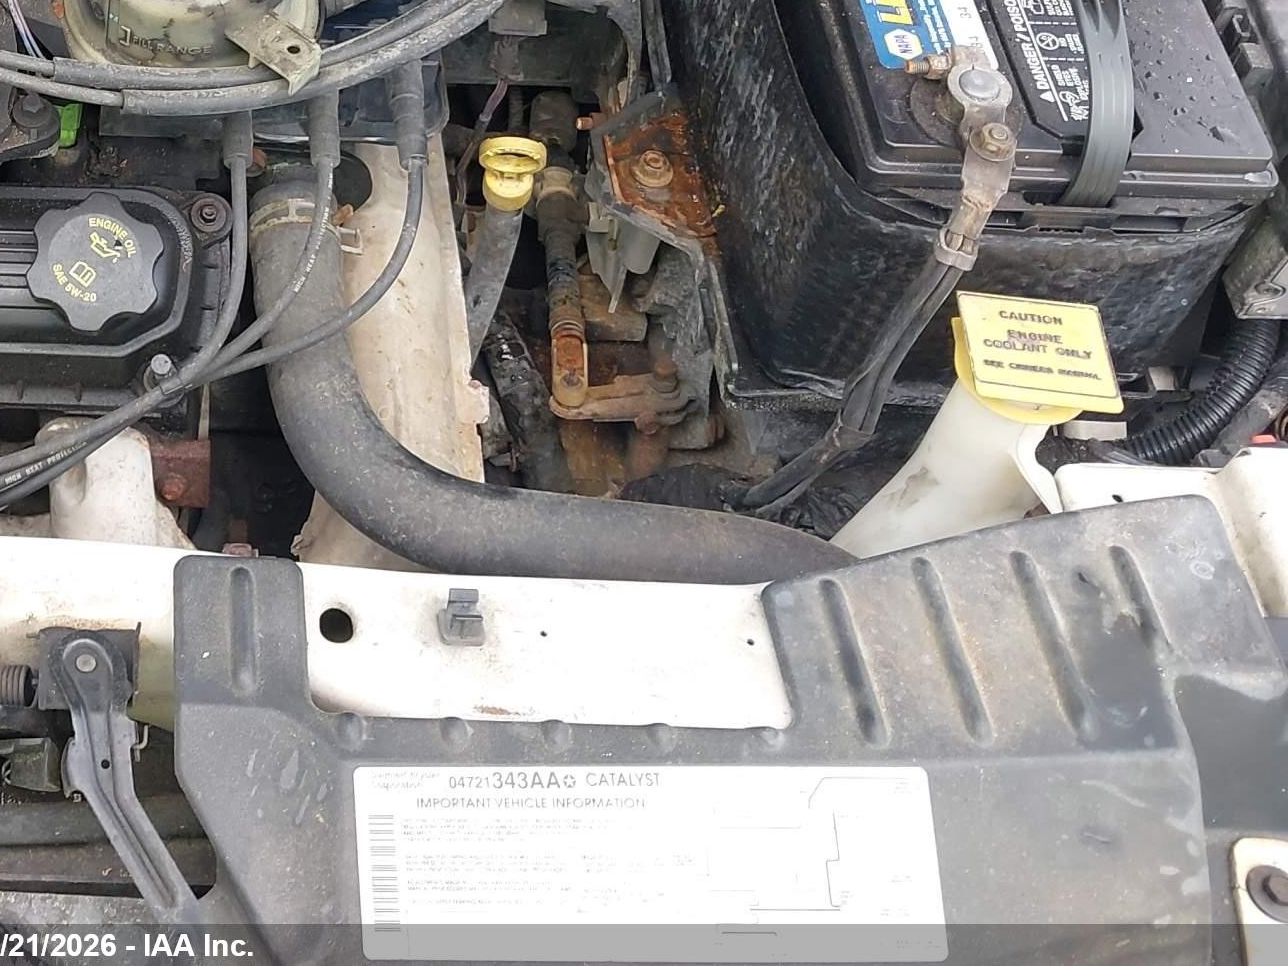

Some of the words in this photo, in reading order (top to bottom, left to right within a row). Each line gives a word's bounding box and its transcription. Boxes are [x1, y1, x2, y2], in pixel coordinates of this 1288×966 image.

[156, 43, 212, 55] RANGE
[893, 34, 913, 54] NAPA
[1019, 42, 1050, 89] DANGER
[88, 217, 128, 241] ENGINE
[123, 238, 137, 259] OIL
[52, 264, 69, 286] SAE
[63, 281, 98, 303] 5W-20
[999, 310, 1063, 326] CAUTION
[1006, 329, 1063, 345] ENGINE
[983, 338, 1048, 354] COOLANT
[1054, 347, 1093, 360] ONLY
[585, 772, 661, 788] CATALYST
[416, 797, 491, 809] IMPORTANT
[495, 797, 548, 809] VEHICLE
[552, 797, 646, 809] INFORMATION
